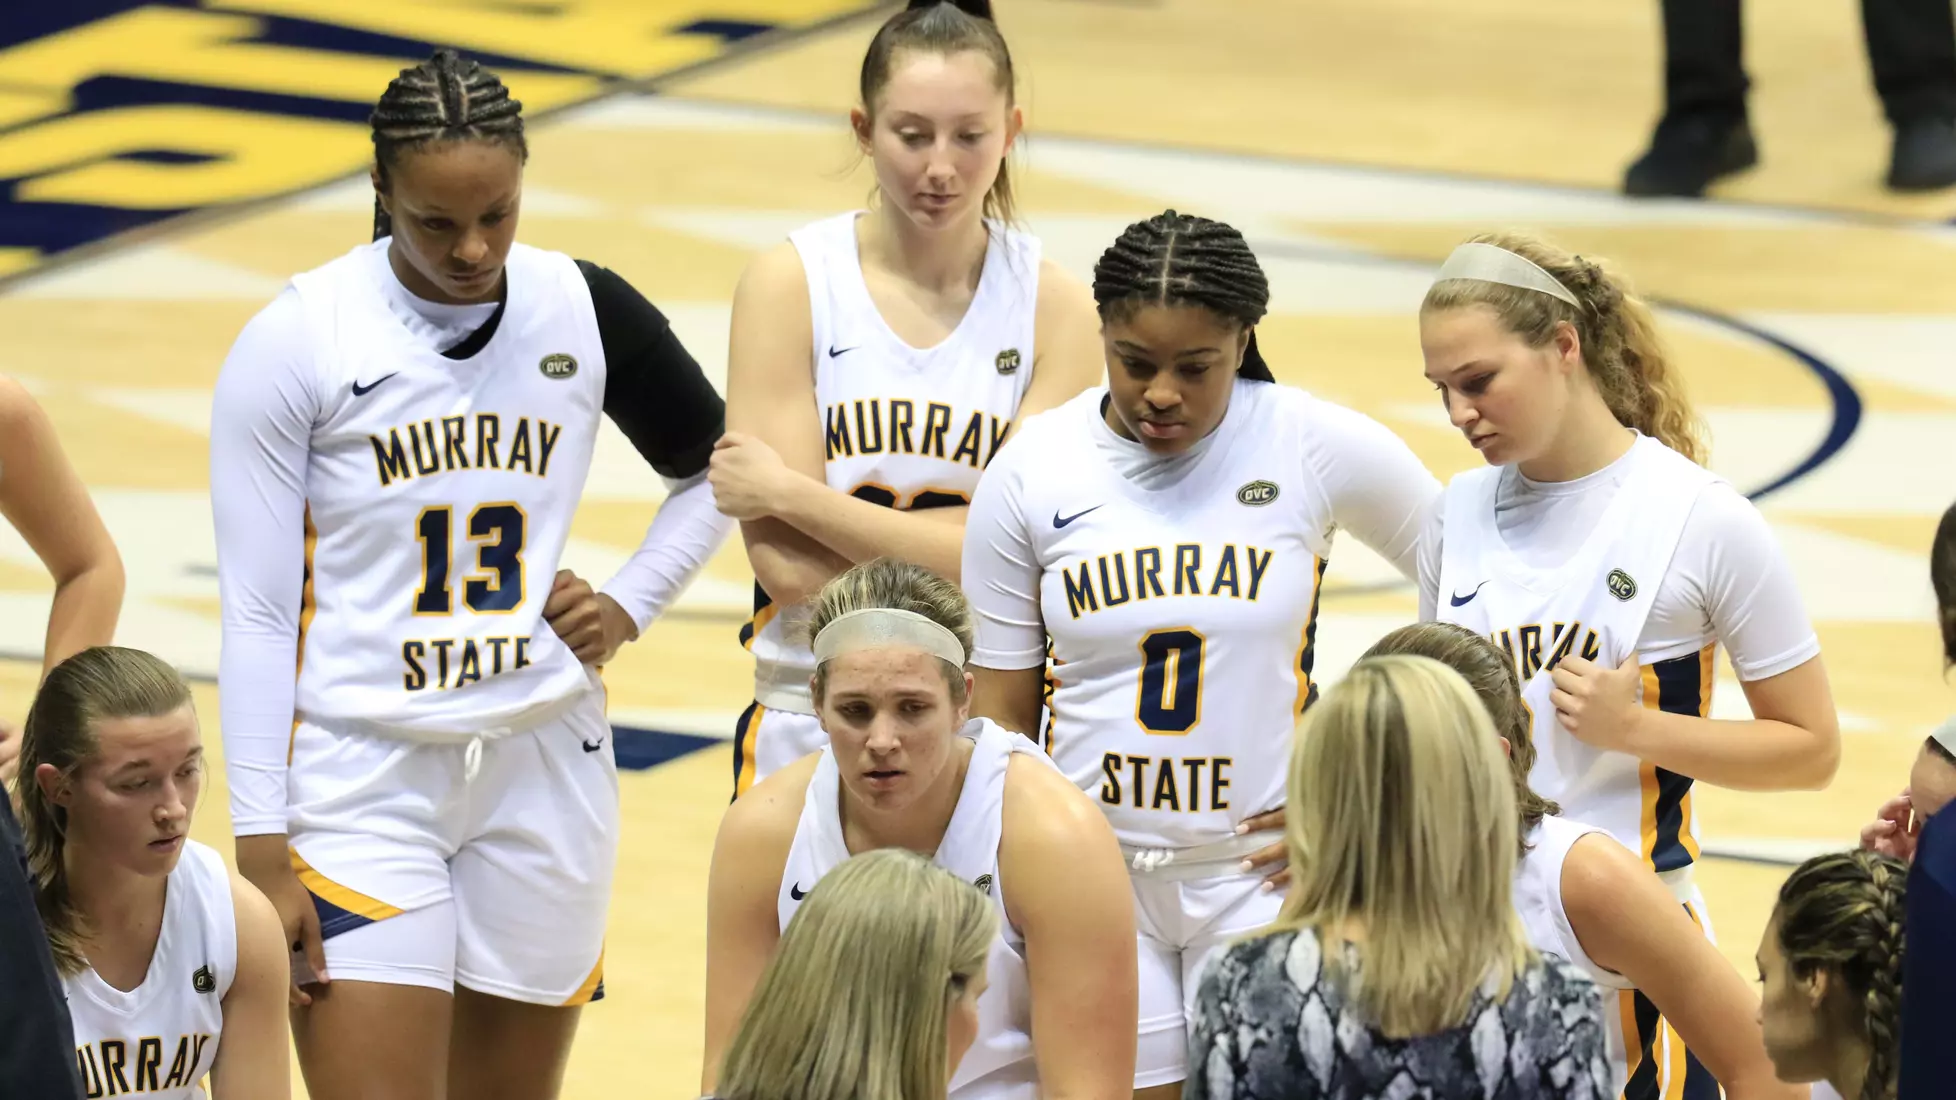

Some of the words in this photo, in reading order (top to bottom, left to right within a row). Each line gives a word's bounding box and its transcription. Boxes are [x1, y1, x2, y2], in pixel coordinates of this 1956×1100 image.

[369, 412, 562, 487] MURRAY
[825, 398, 1011, 471] MURRAY
[411, 500, 528, 616] 13
[1062, 542, 1273, 620] MURRAY
[402, 635, 533, 692] STATE
[1134, 625, 1207, 736] 0
[1101, 752, 1233, 813] STATE
